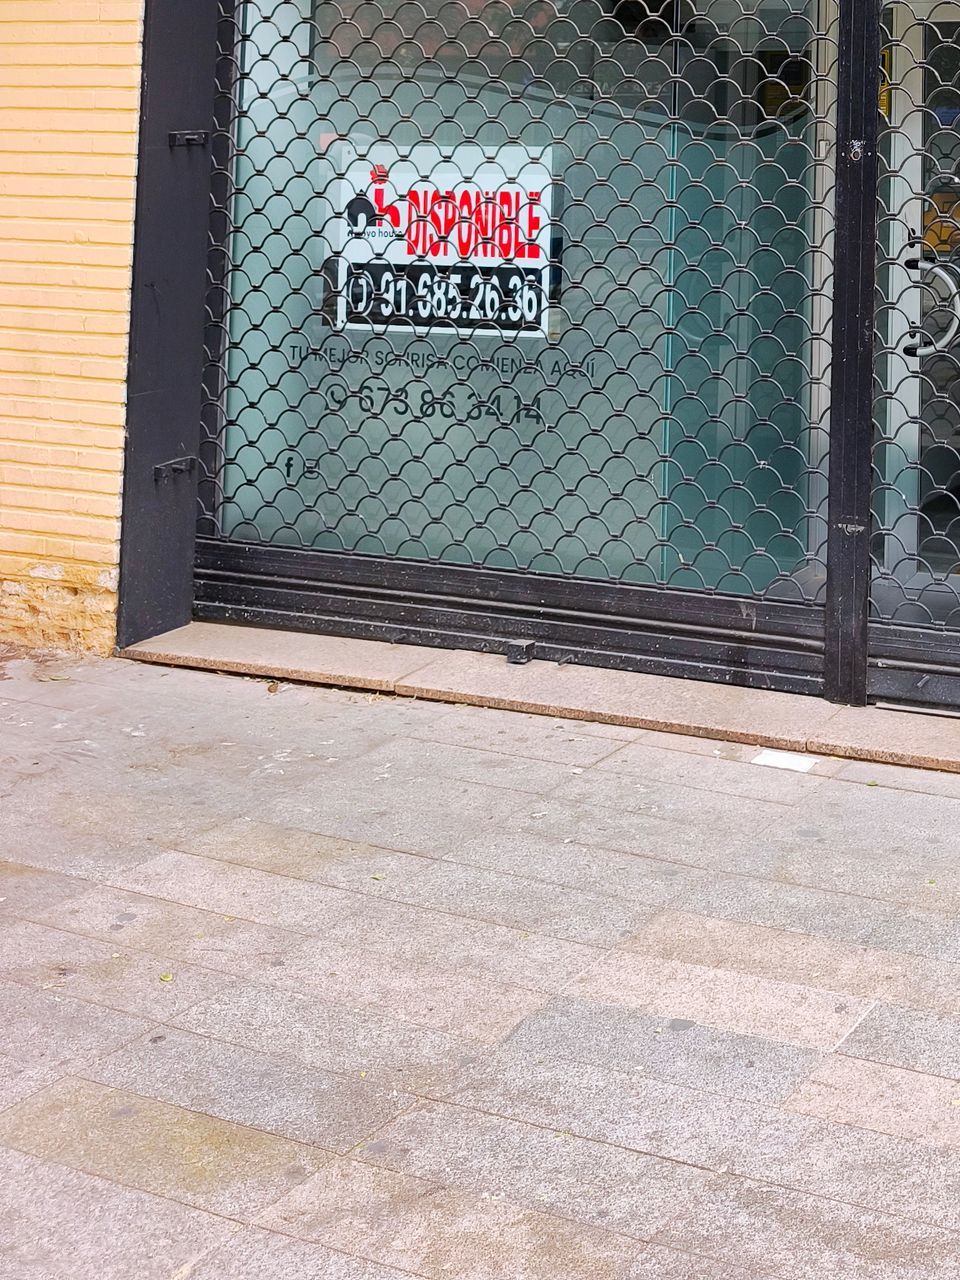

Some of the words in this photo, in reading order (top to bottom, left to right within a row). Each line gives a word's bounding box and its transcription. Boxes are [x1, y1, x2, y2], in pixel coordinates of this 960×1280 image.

[406, 190, 541, 258] DISPONIBLE
[290, 345, 309, 361] TU
[360, 386, 408, 415] 673
[420, 390, 456, 418] 86
[467, 392, 503, 422] 34
[514, 395, 541, 424] 14
